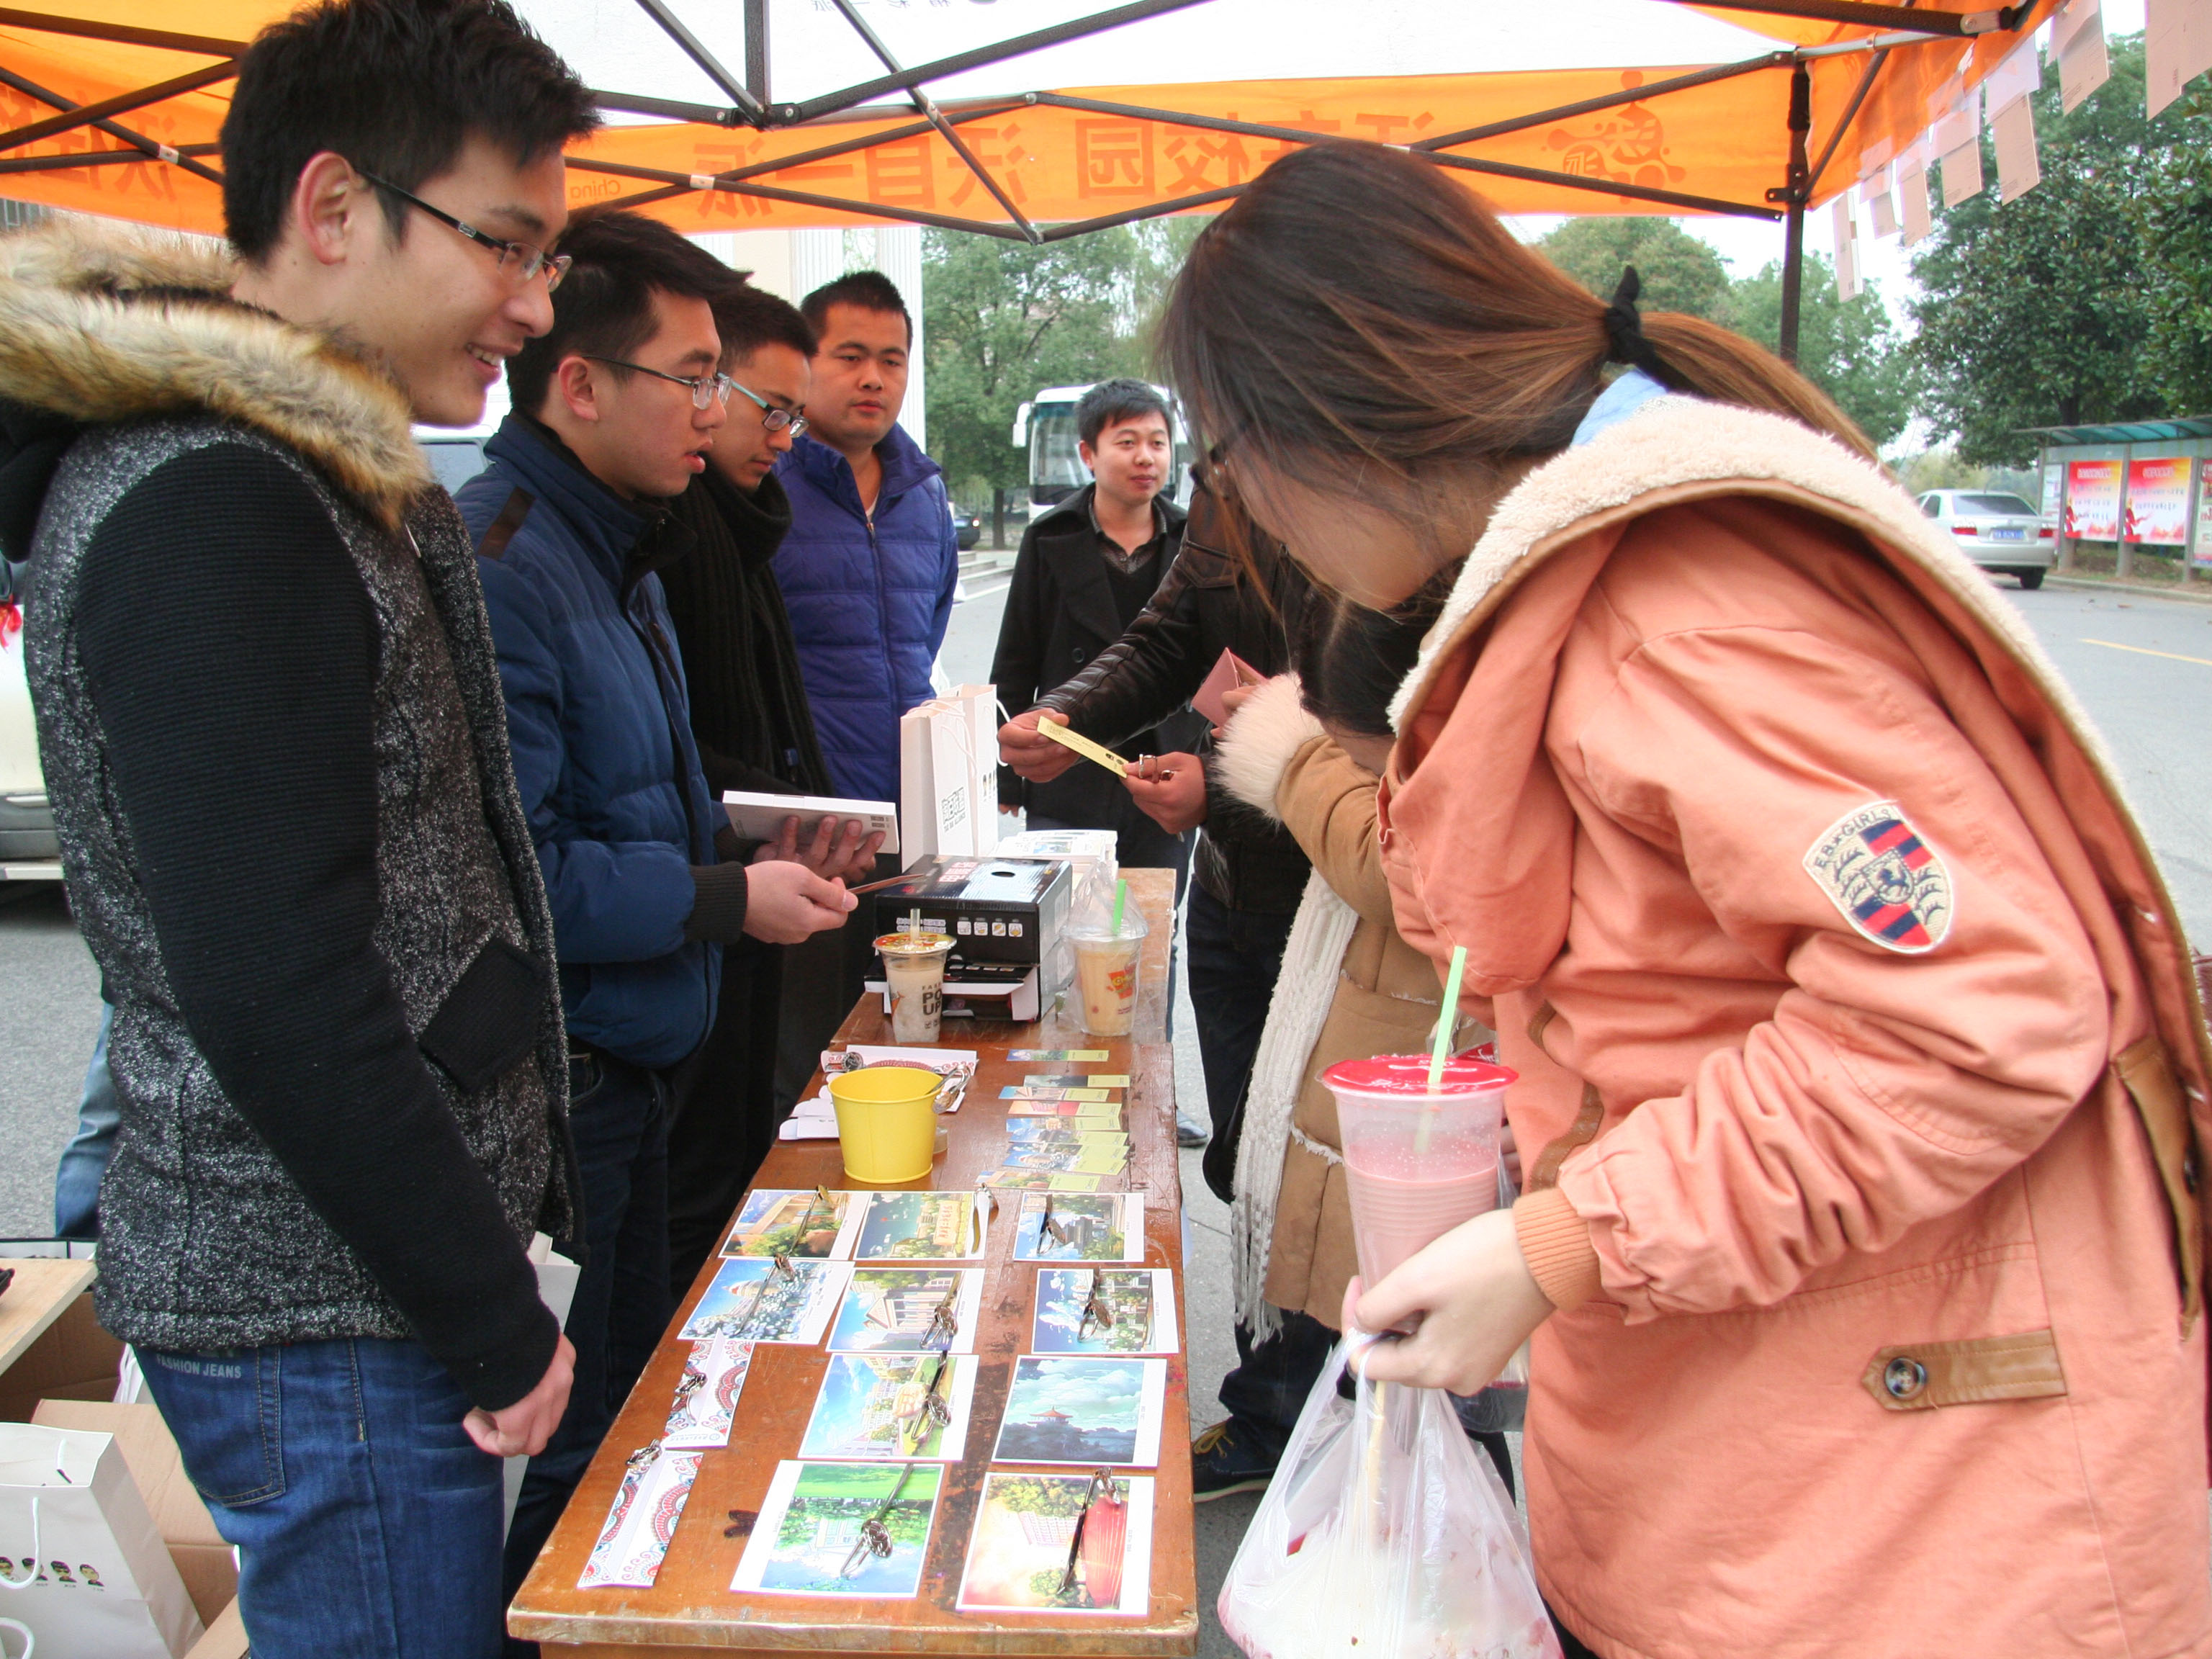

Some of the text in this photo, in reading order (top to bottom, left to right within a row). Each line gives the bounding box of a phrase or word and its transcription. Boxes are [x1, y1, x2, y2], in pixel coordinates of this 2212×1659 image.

[1842, 809, 1892, 837] GIRLS
[157, 1354, 242, 1379] FASHION JEANS
